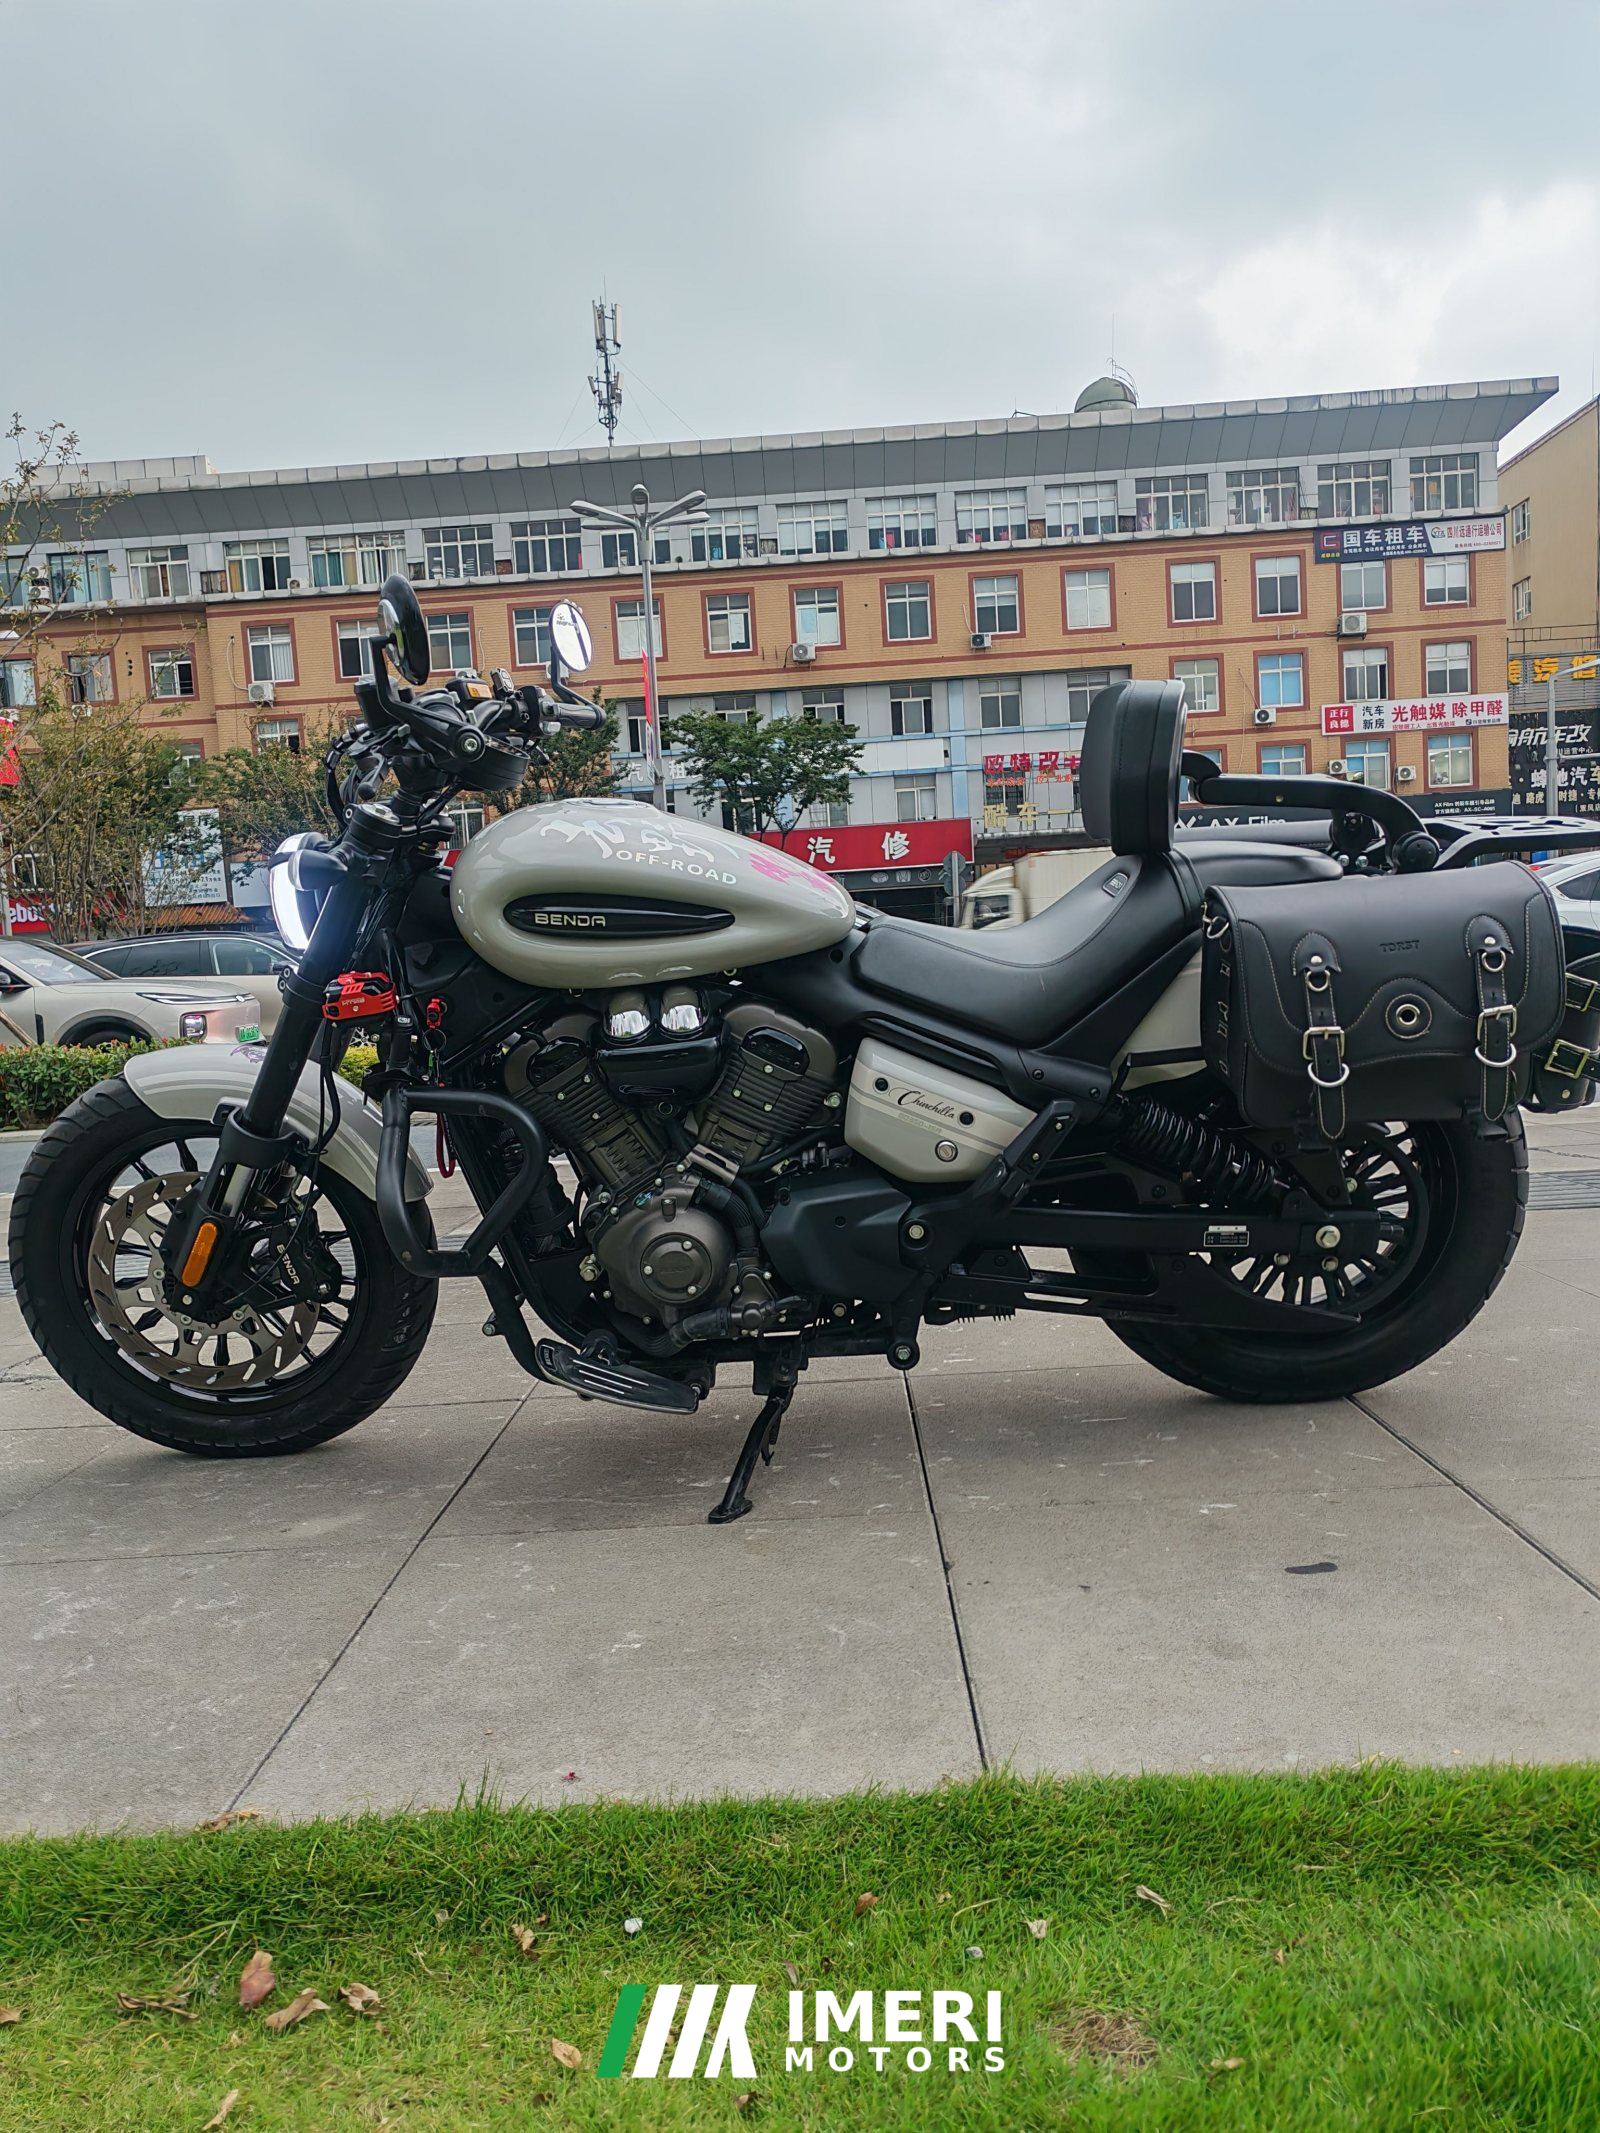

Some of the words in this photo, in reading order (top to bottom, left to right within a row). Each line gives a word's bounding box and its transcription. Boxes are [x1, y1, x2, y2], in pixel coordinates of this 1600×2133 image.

[1343, 525, 1424, 548] 国车租车
[1362, 705, 1385, 717] 汽车
[1391, 702, 1447, 723] 光触媒
[1452, 699, 1503, 718] 除甲醛
[1362, 718, 1385, 730] 新房
[616, 850, 737, 885] OFF-ROAD
[534, 913, 606, 927] BENDA
[889, 1087, 955, 1119] Chinchilla
[276, 1244, 300, 1285] BENDA
